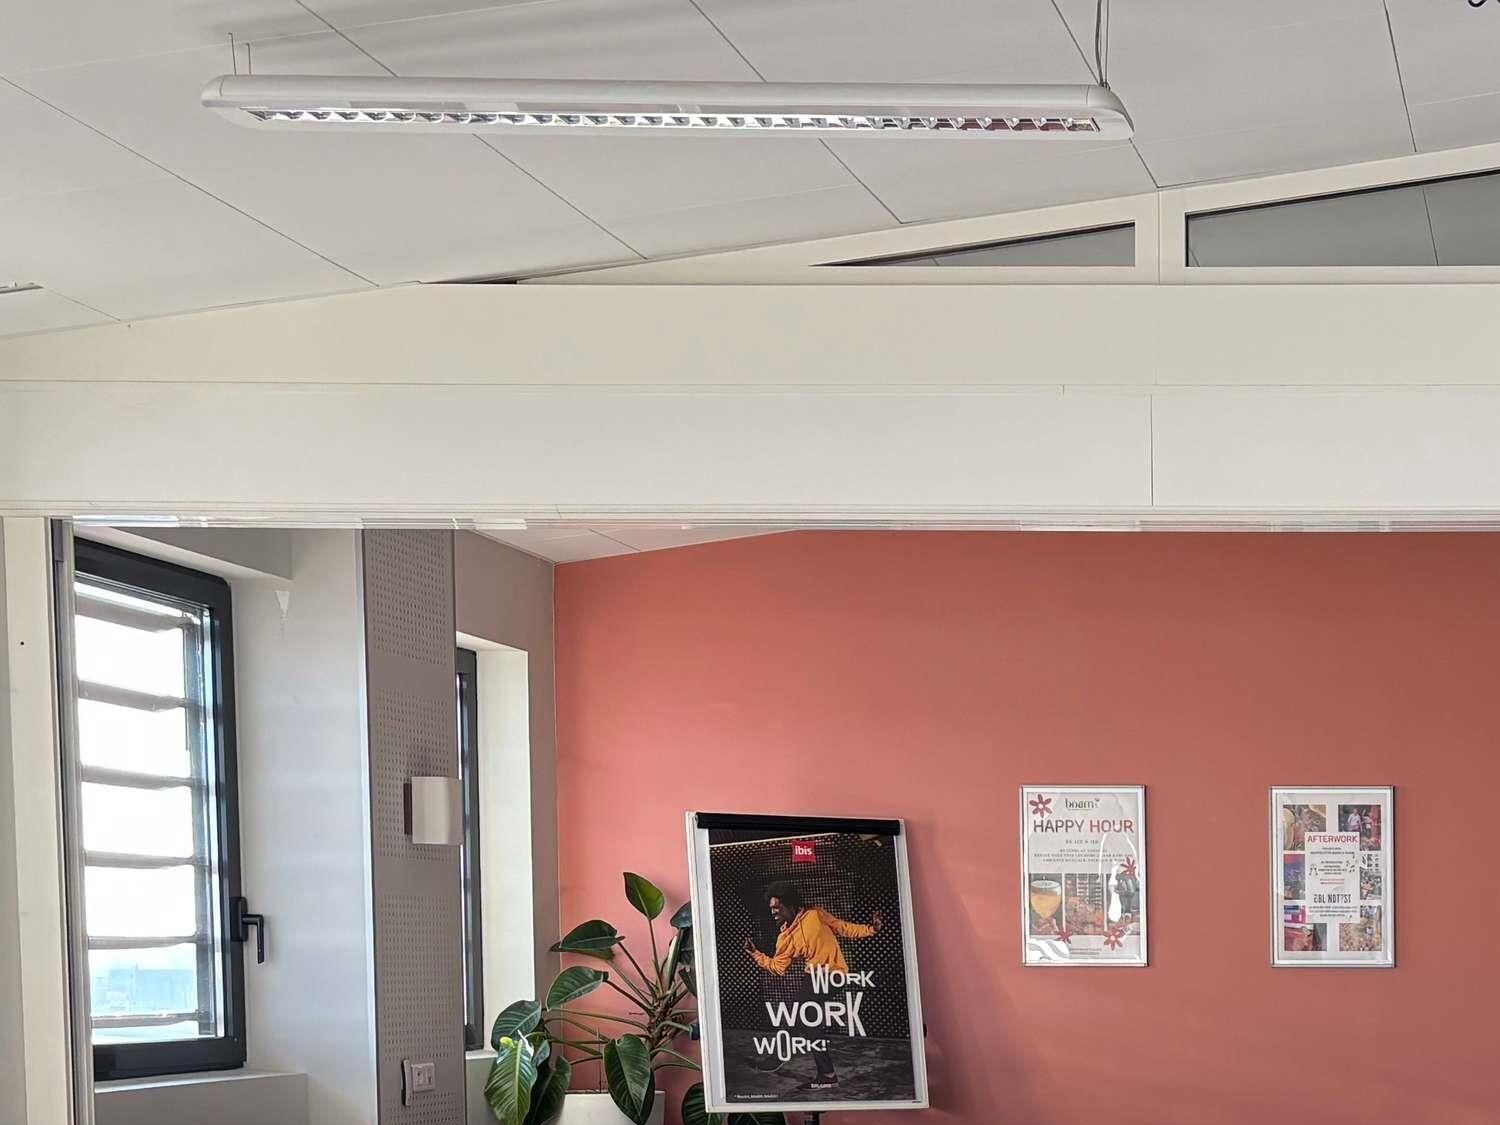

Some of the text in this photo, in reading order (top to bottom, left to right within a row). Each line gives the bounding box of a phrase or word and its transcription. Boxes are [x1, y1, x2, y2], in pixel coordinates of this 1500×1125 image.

[1033, 819, 1135, 833] HAPPY HOUR
[1307, 835, 1358, 844] AFTERWORK
[795, 845, 812, 855] ibis
[810, 963, 876, 994] WORK
[765, 991, 867, 1037] WORK
